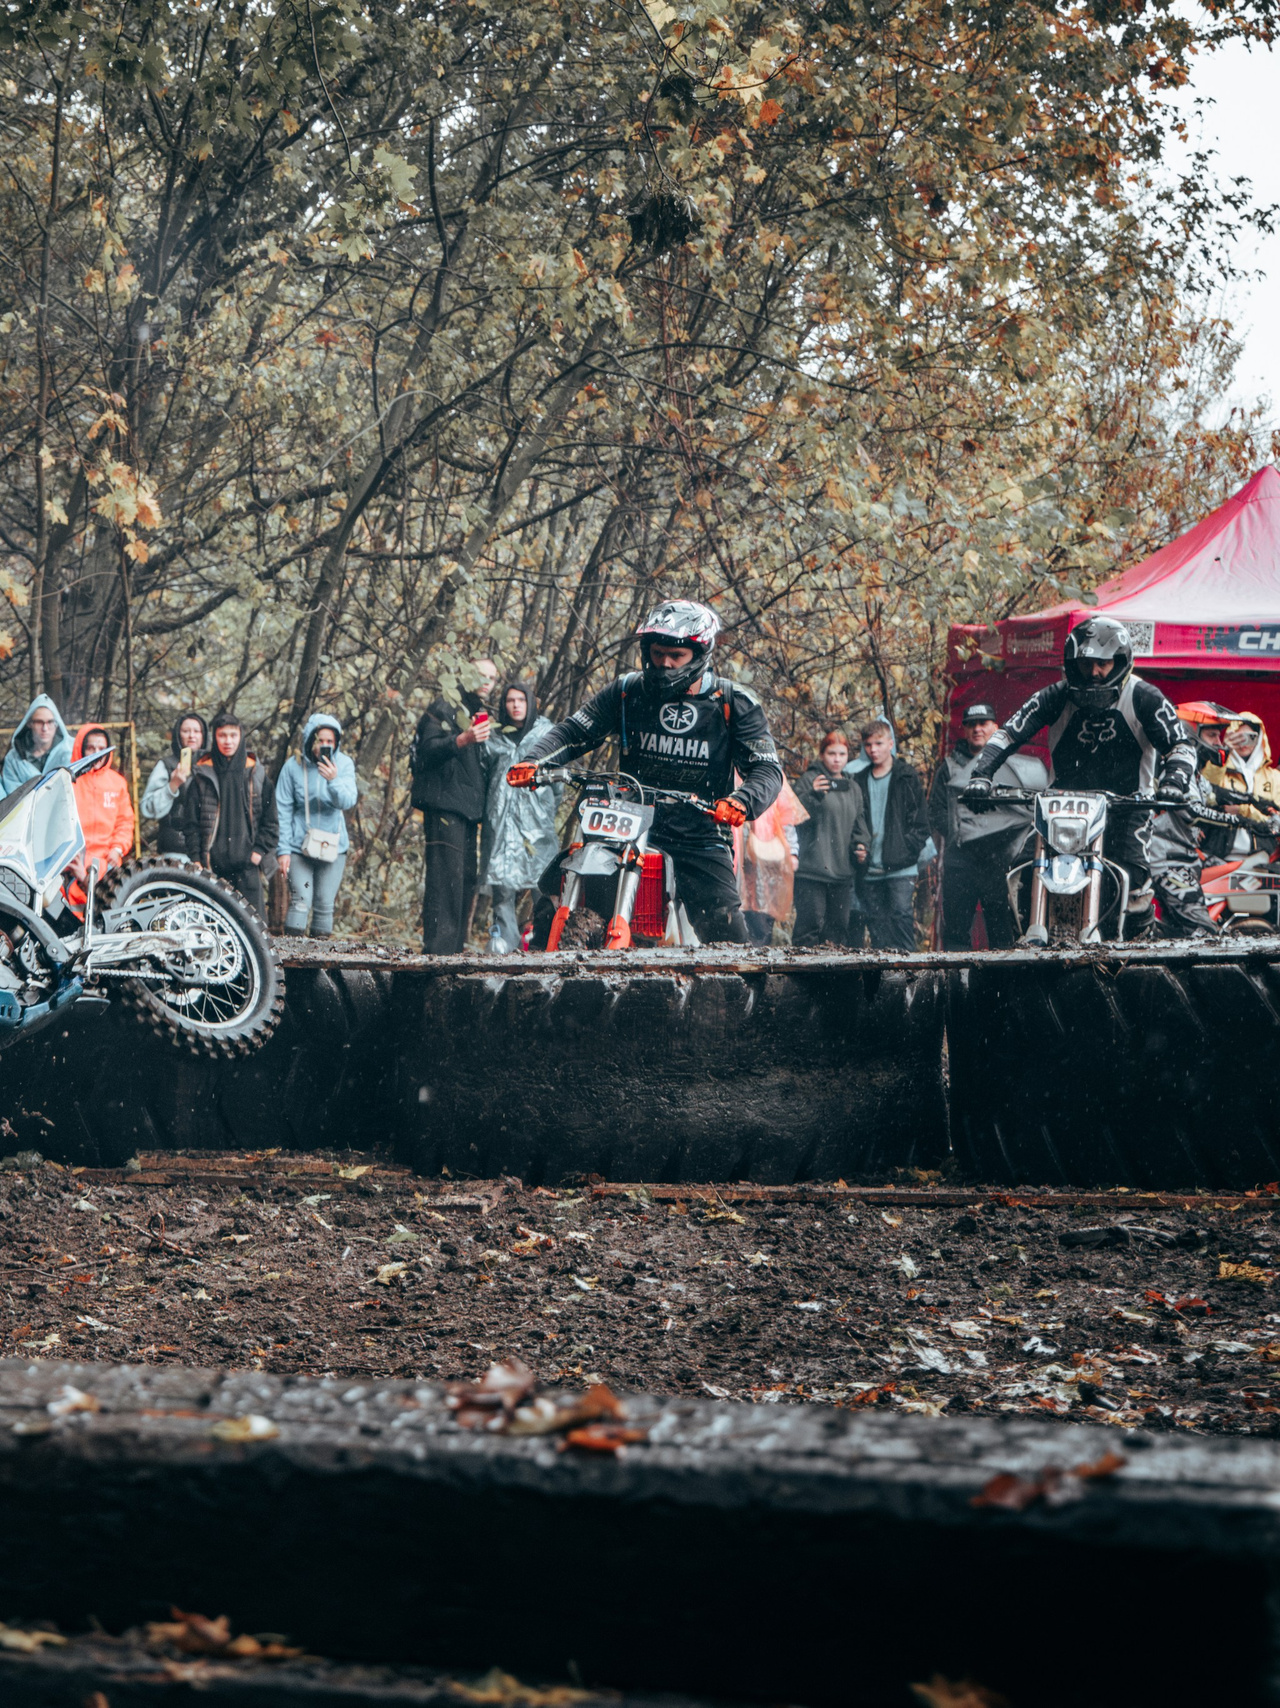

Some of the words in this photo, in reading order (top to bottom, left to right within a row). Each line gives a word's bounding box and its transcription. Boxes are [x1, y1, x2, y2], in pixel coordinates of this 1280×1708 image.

[640, 732, 710, 759] YAMAHA
[639, 752, 674, 762] FACTORY
[677, 759, 709, 767] RACING
[1048, 800, 1089, 815] 040
[588, 811, 633, 837] 038
